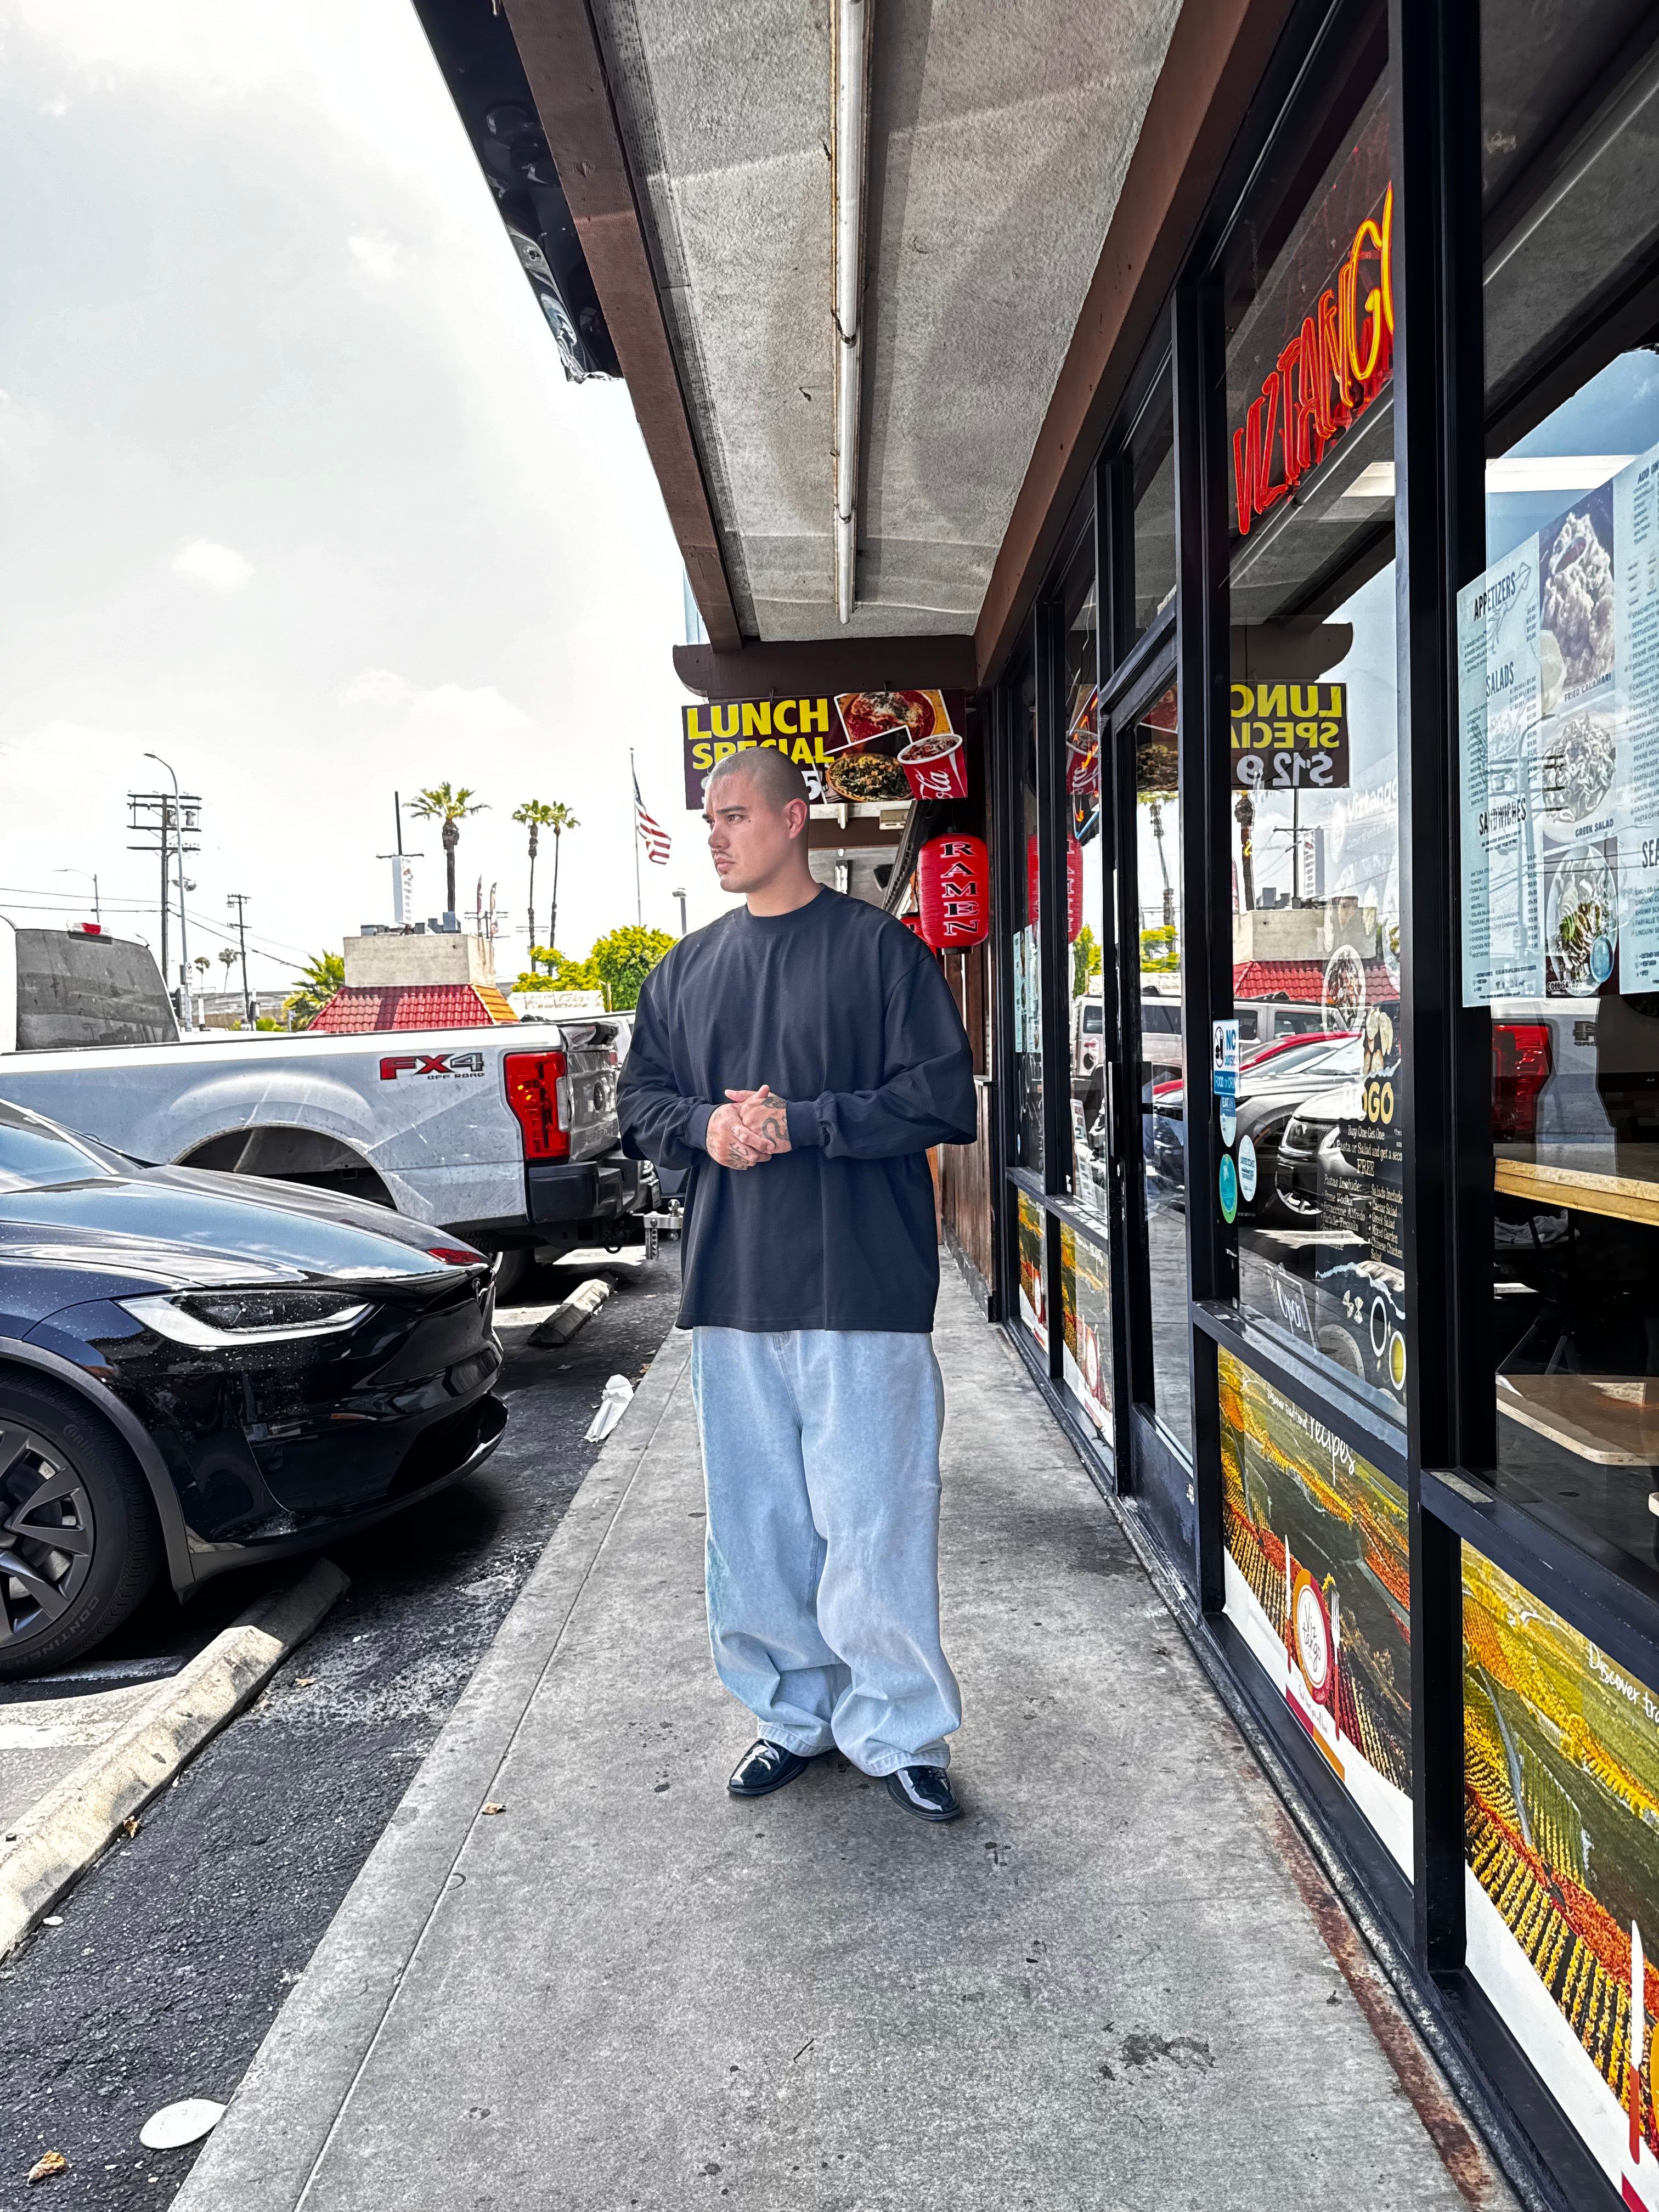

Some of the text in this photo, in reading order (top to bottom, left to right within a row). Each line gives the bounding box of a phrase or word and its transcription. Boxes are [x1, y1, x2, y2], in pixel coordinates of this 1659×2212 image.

[1233, 180, 1394, 535] VIZTANG
[1638, 468, 1649, 484] ADD
[1474, 571, 1515, 622] APPETIZERS
[1486, 661, 1514, 697] SALADS
[1565, 672, 1611, 702] FRIED CALAMARI
[686, 698, 829, 740] LUNCH
[692, 737, 835, 770] SPIAL
[1479, 798, 1526, 836] SANDWICHES
[1634, 814, 1647, 823] PASTA
[1575, 818, 1613, 837] GREEK SALAD
[940, 841, 981, 936] RAMEN
[1547, 981, 1561, 991] COBB
[380, 1052, 485, 1080] FX4
[1348, 1125, 1358, 1139] Buy
[1358, 1126, 1367, 1138] One
[1368, 1127, 1376, 1138] Get
[1376, 1128, 1385, 1141] One
[1336, 1139, 1351, 1152] Pasta
[1358, 1142, 1372, 1155] Salad
[1380, 1148, 1389, 1161] get
[1389, 1151, 1392, 1160] a
[1392, 1152, 1403, 1161] seco
[1357, 1158, 1374, 1176] FREE
[1324, 1174, 1362, 1192] Pastas Include:
[1372, 1183, 1386, 1199] Salads
[1337, 1193, 1353, 1206] Vodka
[1372, 1199, 1398, 1217] Caesar Salad
[1347, 1207, 1365, 1221] Alfredo
[1372, 1211, 1395, 1230] Greek Salad
[1339, 1217, 1359, 1232] Tequila
[1372, 1223, 1398, 1244] Mixed Garden
[1370, 1248, 1382, 1262] Salad
[1372, 1236, 1403, 1259] Chinese Chicken
[1310, 1416, 1356, 1486] recipes
[1589, 1641, 1640, 1705] Discover
